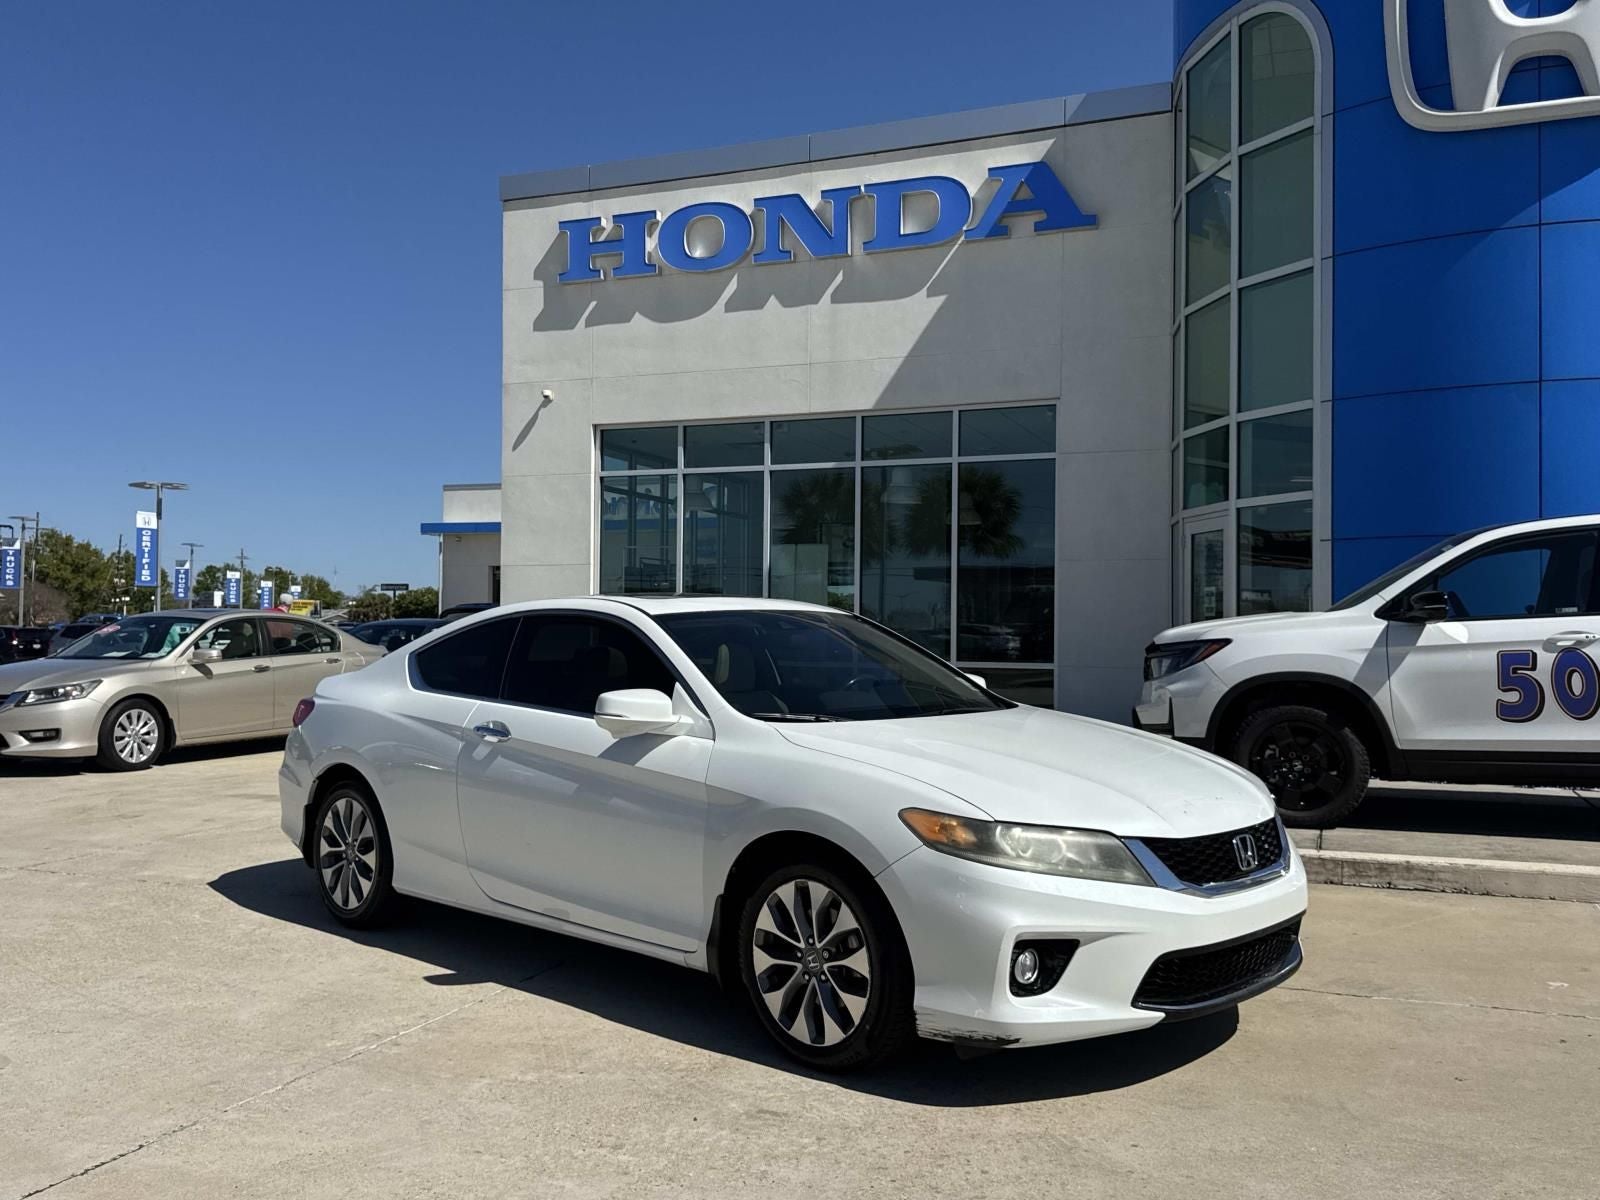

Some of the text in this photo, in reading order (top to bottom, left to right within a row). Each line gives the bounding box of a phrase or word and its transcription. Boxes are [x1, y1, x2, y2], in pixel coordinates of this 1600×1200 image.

[557, 161, 1097, 284] HONDA
[5, 549, 15, 586] TRUCKS
[141, 529, 152, 581] CERTIFIED
[178, 569, 186, 597] TRUCKS
[1496, 646, 1600, 723] 50
